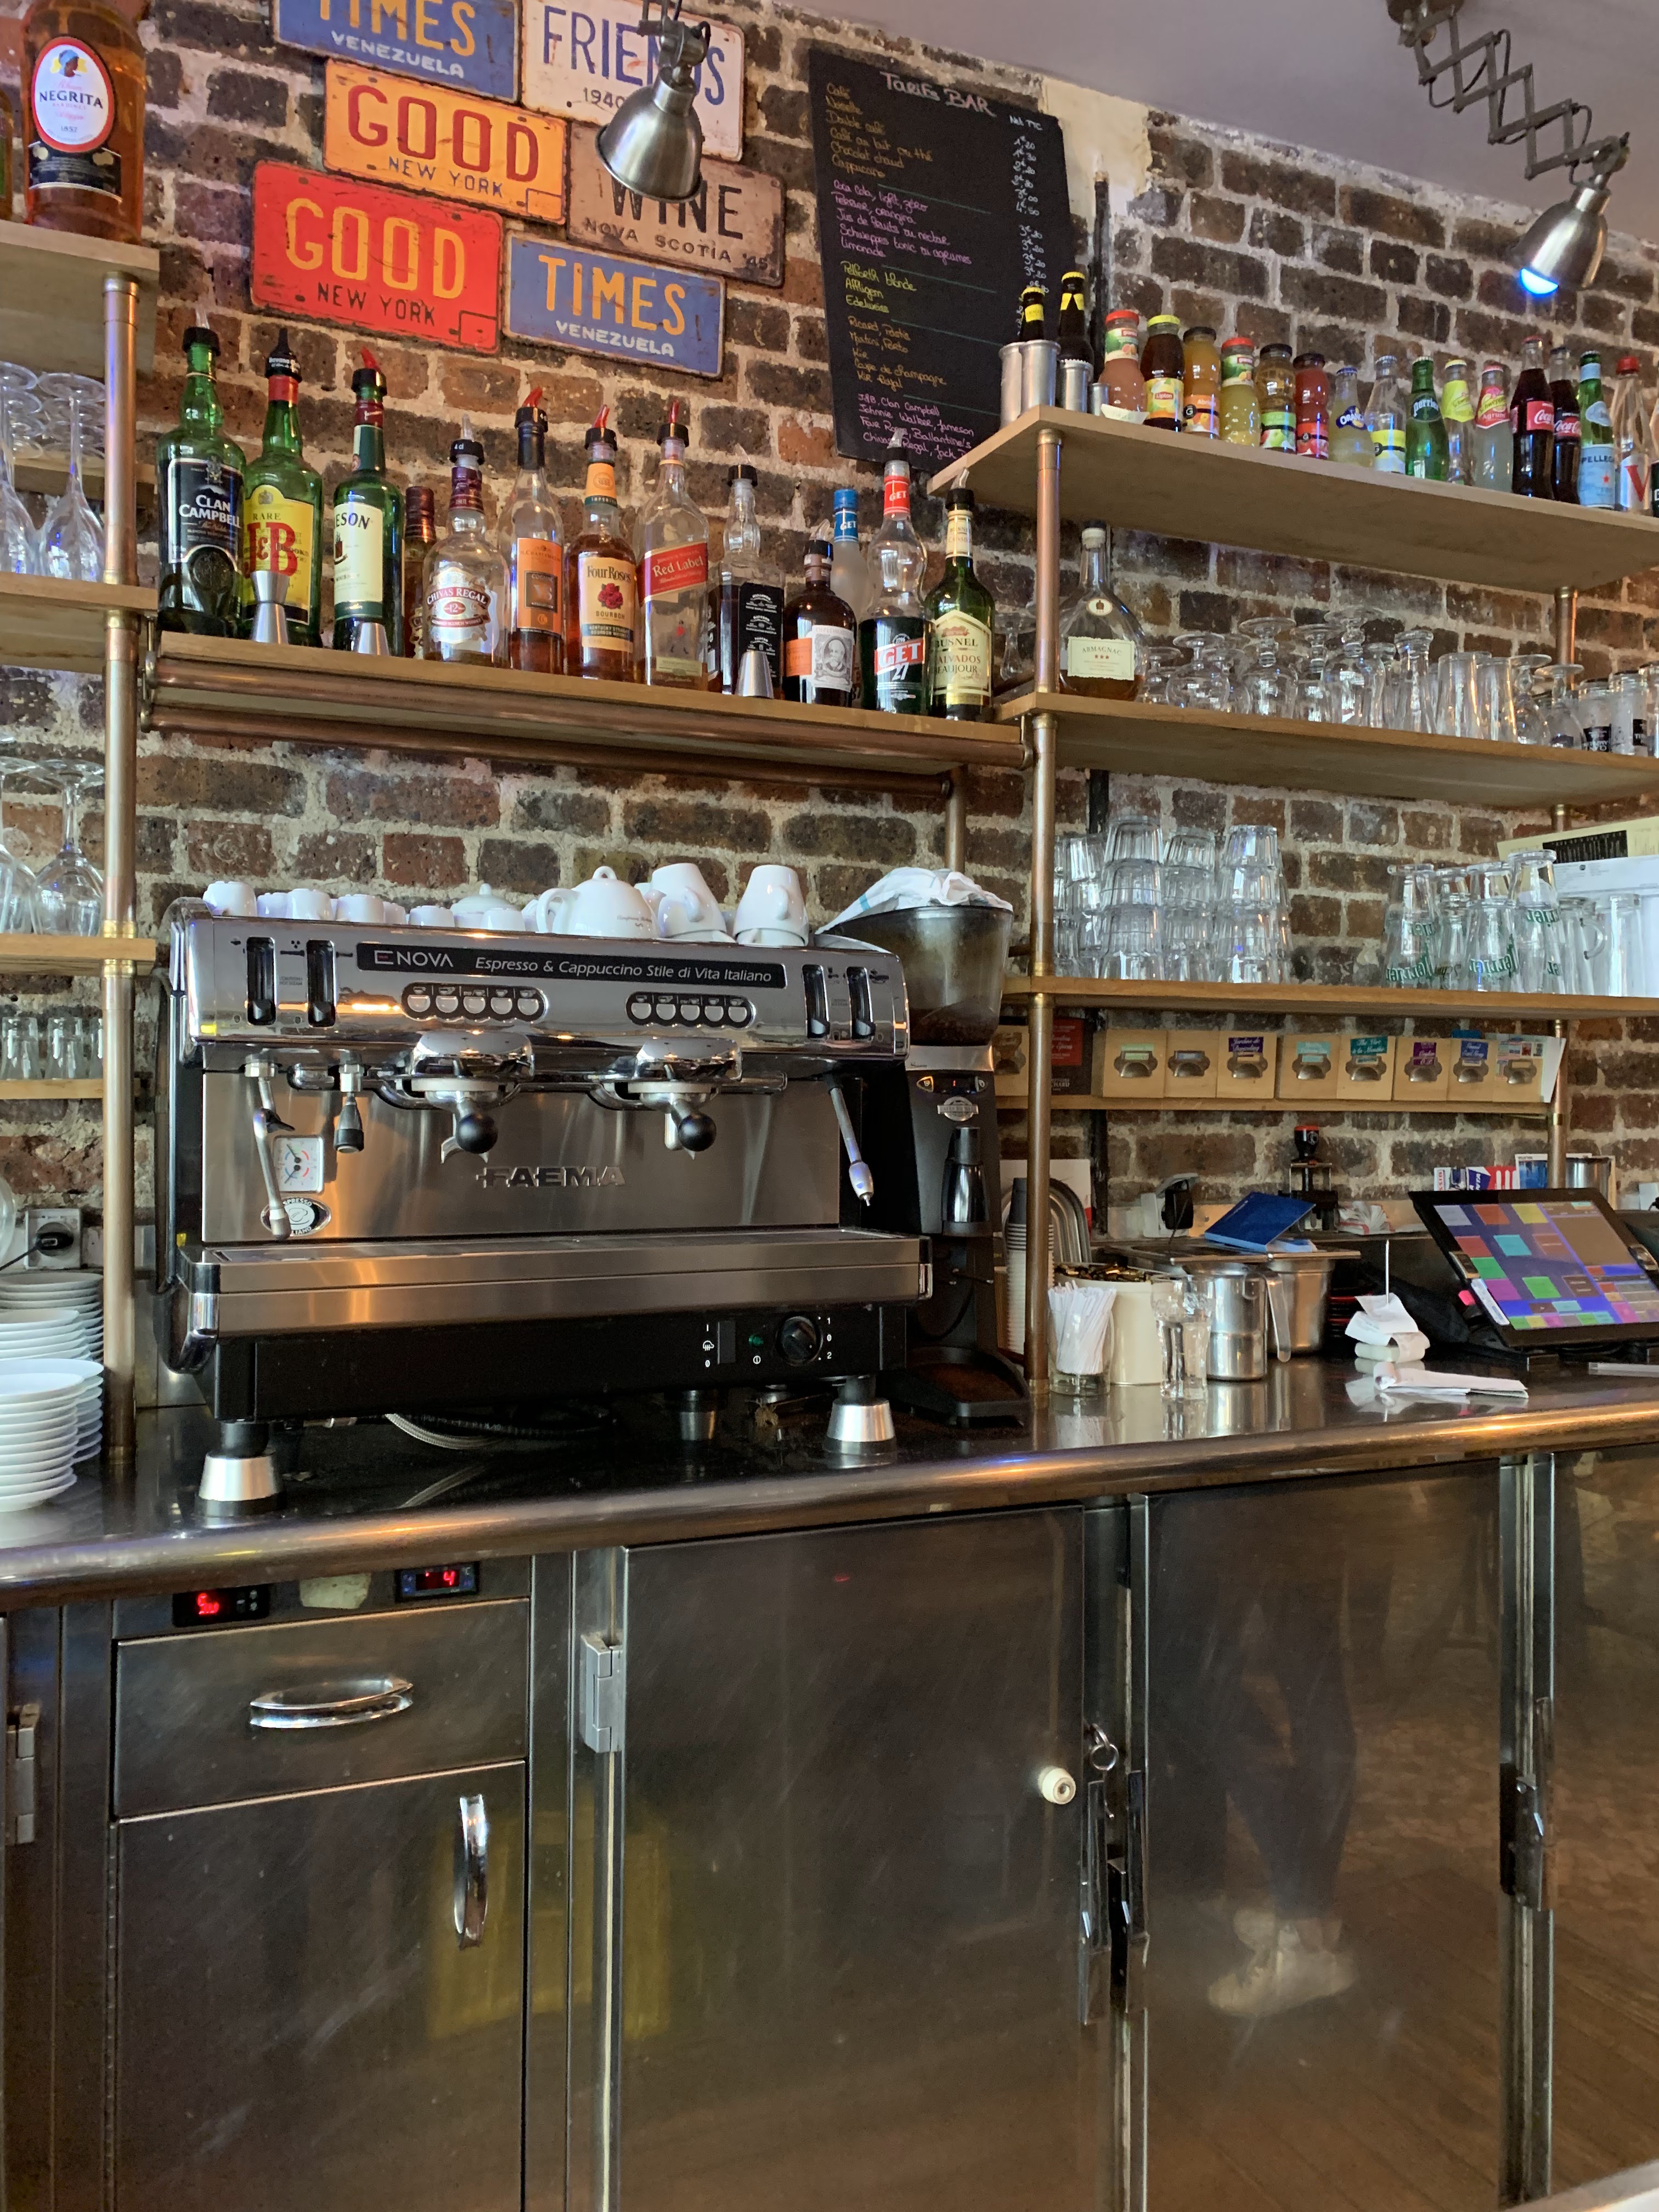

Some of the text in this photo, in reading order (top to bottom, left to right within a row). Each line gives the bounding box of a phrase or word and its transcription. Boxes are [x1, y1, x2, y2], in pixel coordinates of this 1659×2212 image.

[331, 30, 464, 79] VENEZUELA
[543, 5, 725, 106] FRIES
[39, 89, 104, 109] NEGRITA
[943, 87, 996, 117] BAR
[347, 84, 539, 182] GOOD
[388, 155, 503, 199] NEW YORK
[285, 198, 465, 300] GOOD
[585, 218, 639, 244] NOVA
[655, 235, 732, 263] SCOTIA
[884, 272, 918, 292] blonde
[317, 281, 436, 326] NEW YORK
[538, 254, 686, 336] TIMES
[556, 320, 675, 358] VENEZUELA
[195, 494, 230, 512] CLAN
[889, 490, 907, 501] GET
[178, 503, 241, 529] CAMPBELL
[252, 512, 281, 521] RARE
[334, 512, 370, 530] ESON
[840, 520, 856, 531] GET
[587, 566, 608, 578] Four
[652, 562, 675, 577] Red
[676, 555, 704, 571] Label
[427, 588, 487, 605] CHIVAS REGAL
[449, 603, 459, 613] 12
[595, 611, 625, 620] BOURBON
[878, 642, 921, 669] GET
[938, 654, 981, 664] ALVADOS
[1081, 645, 1123, 656] ARMAGNAC
[891, 662, 910, 681] 27
[374, 950, 772, 983] ENOVA Espresso & Cappuccino Stile di Vita Italiano
[476, 1165, 626, 1189] FAEMA
[283, 1198, 313, 1207] SPRESSO
[291, 1225, 312, 1236] LIANO
[826, 1351, 832, 1359] 2
[442, 1570, 456, 1585] 4
